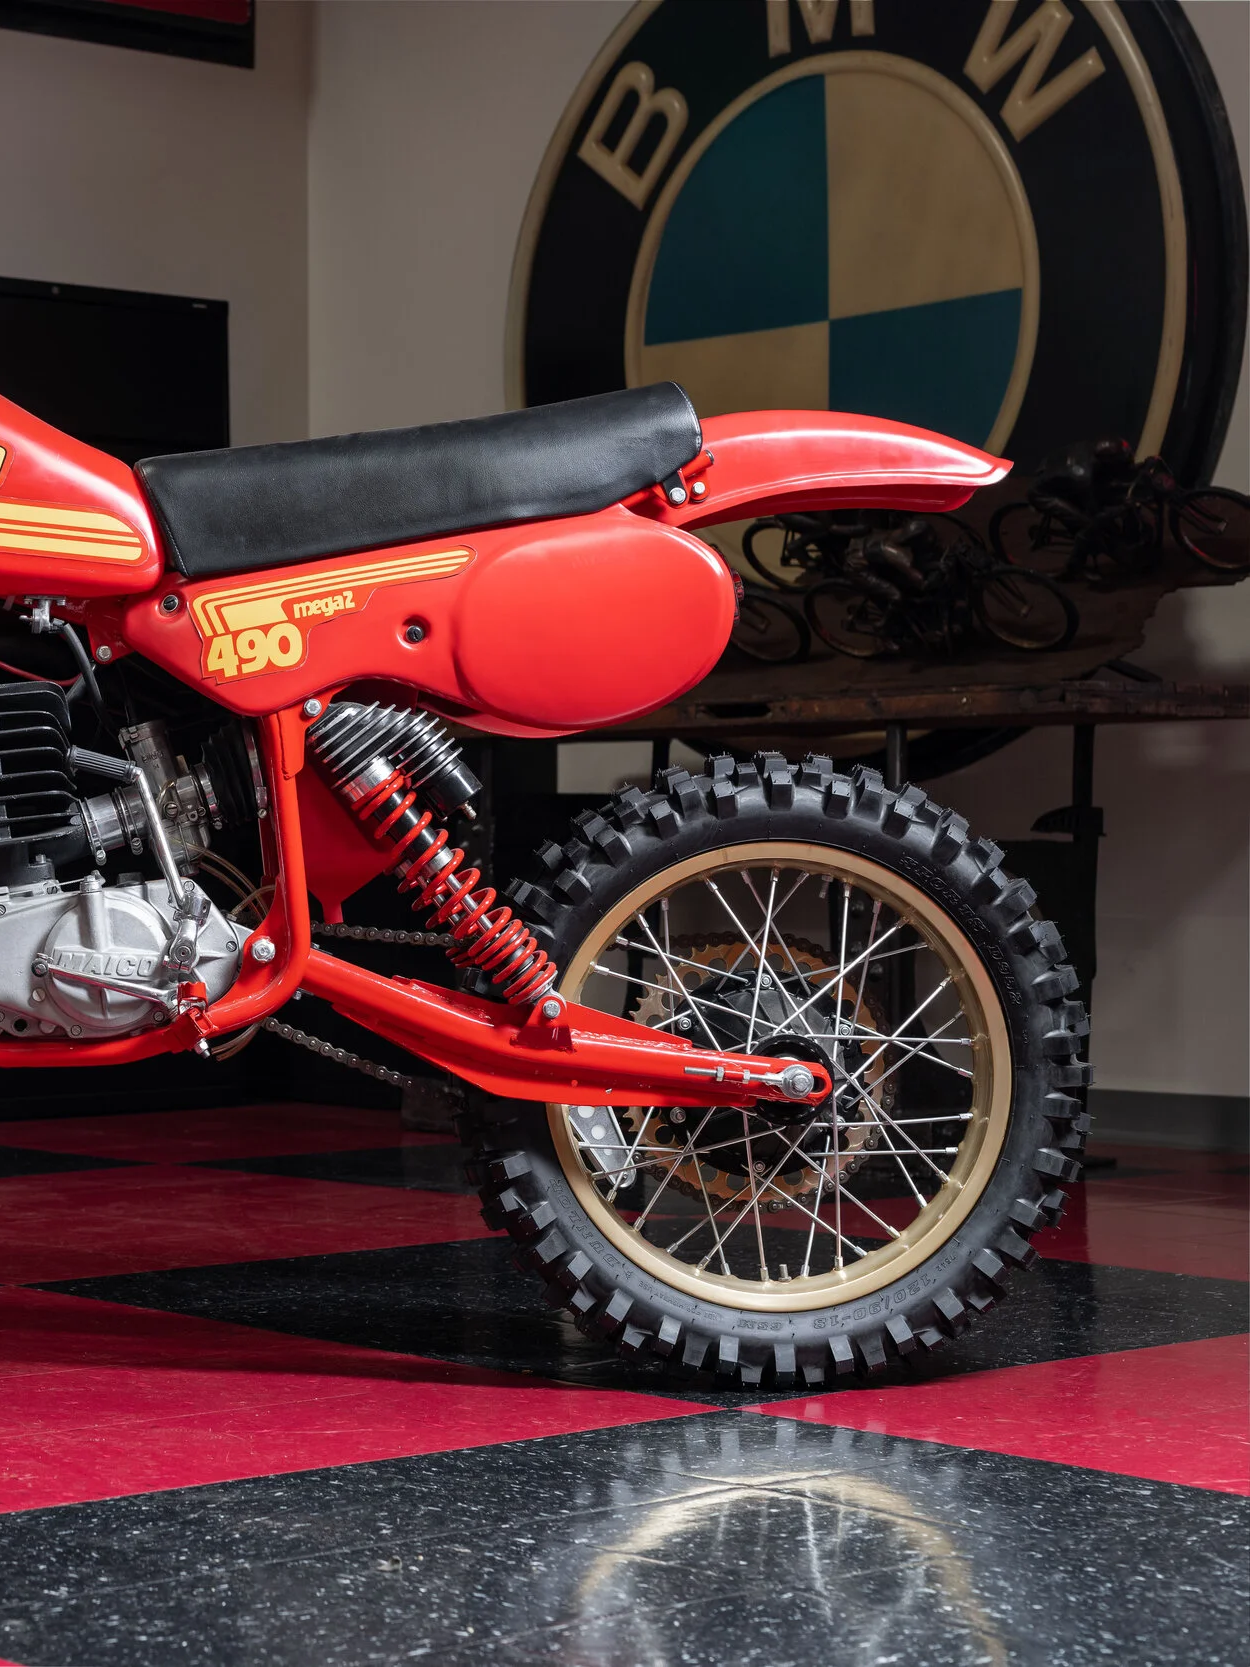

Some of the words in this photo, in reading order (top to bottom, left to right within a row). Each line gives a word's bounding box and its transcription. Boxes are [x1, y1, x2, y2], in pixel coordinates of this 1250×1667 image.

[578, 0, 1105, 211] BMW
[207, 623, 303, 678] 490
[57, 951, 158, 978] MAICO
[813, 1273, 934, 1330] 120/90-18
